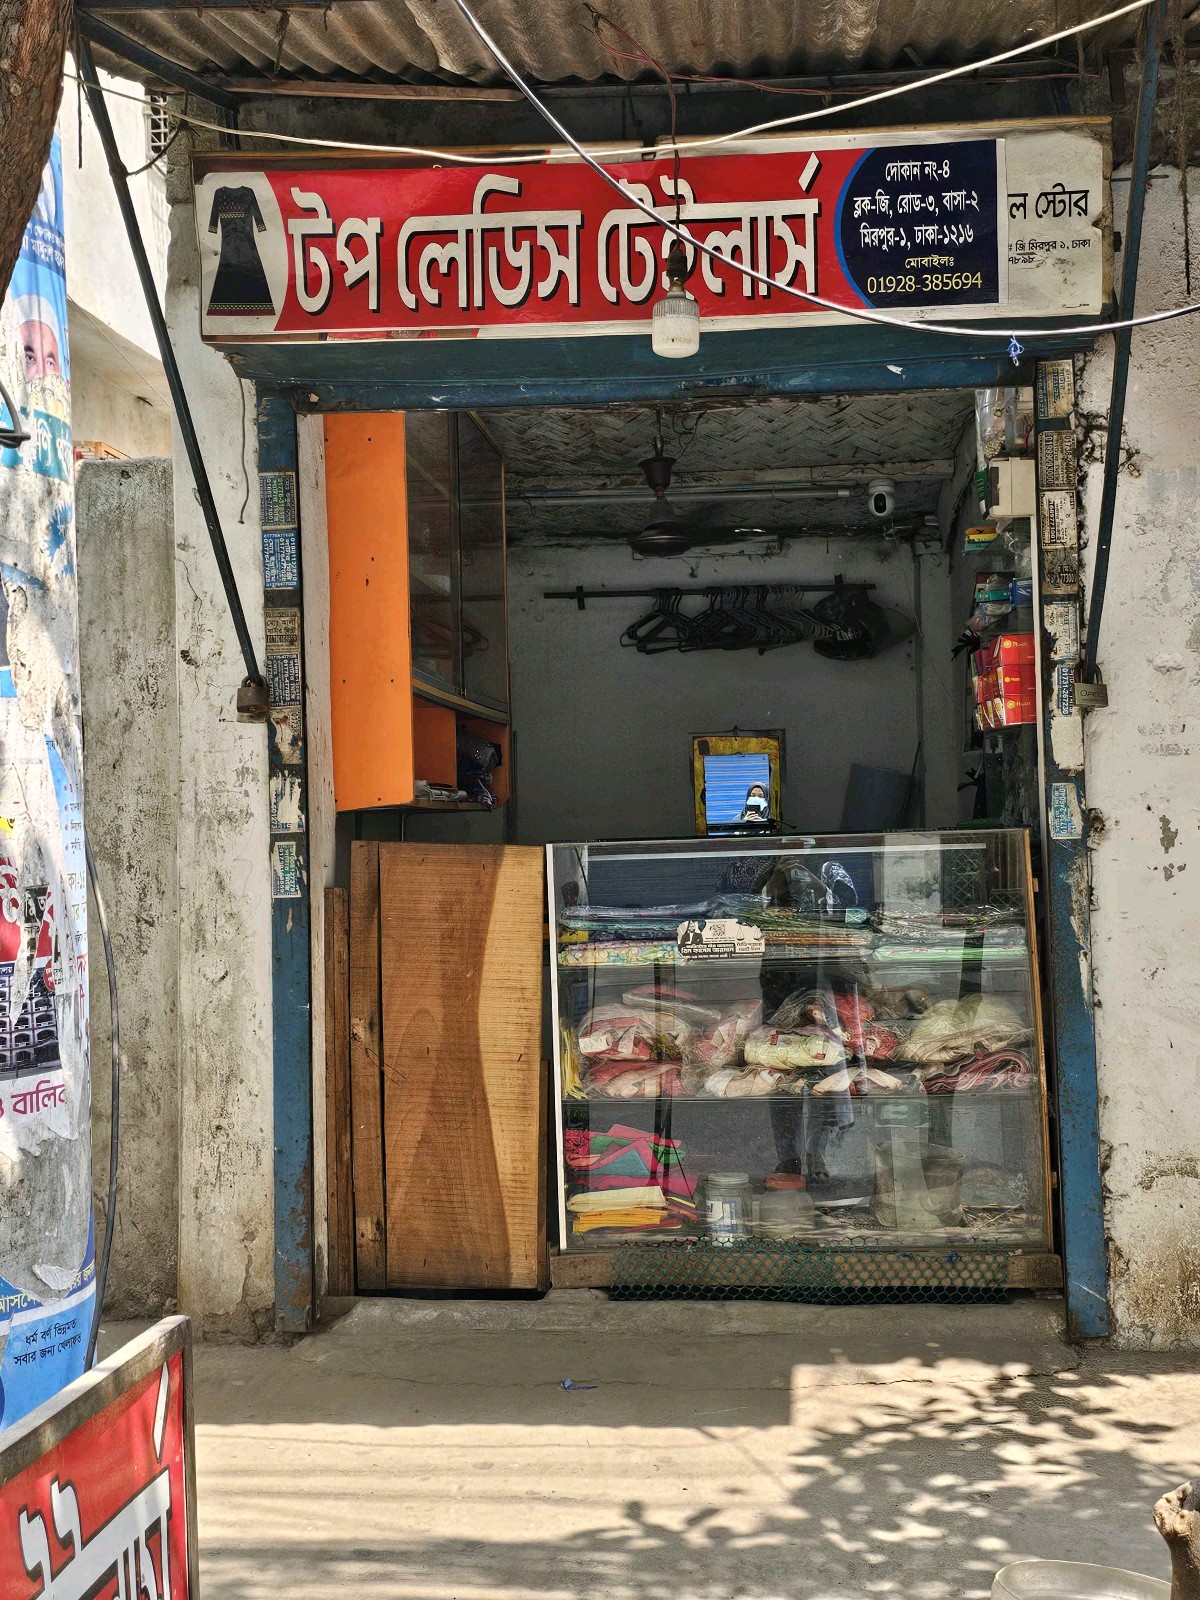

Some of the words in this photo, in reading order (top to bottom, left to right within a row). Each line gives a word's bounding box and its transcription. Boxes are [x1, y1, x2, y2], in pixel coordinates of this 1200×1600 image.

[885, 160, 921, 181] দোকান
[924, 159, 950, 181] নং-৪
[853, 189, 893, 219] ব্লক-জি,
[897, 192, 939, 217] রোড-৩,
[942, 188, 980, 213] বাসা-২
[1035, 182, 1089, 220] স্টোর
[287, 186, 383, 313] টপ
[397, 173, 584, 309] লেডিস
[597, 152, 821, 302] টেইলার্স
[860, 222, 911, 252] মিরপুর-১,
[914, 223, 974, 248] ঢাকা-১২১৬
[1015, 239, 1026, 252] জি
[1028, 238, 1057, 252] মিরপুর
[1072, 239, 1091, 249] ঢাকা
[905, 255, 955, 269] মোবাইলঃ
[867, 271, 983, 294] 01928-385694
[25, 1328, 39, 1346] ধর্ম
[40, 1324, 53, 1342] বর্ণ
[13, 1350, 37, 1366] সবার
[39, 1344, 56, 1359] জন্য
